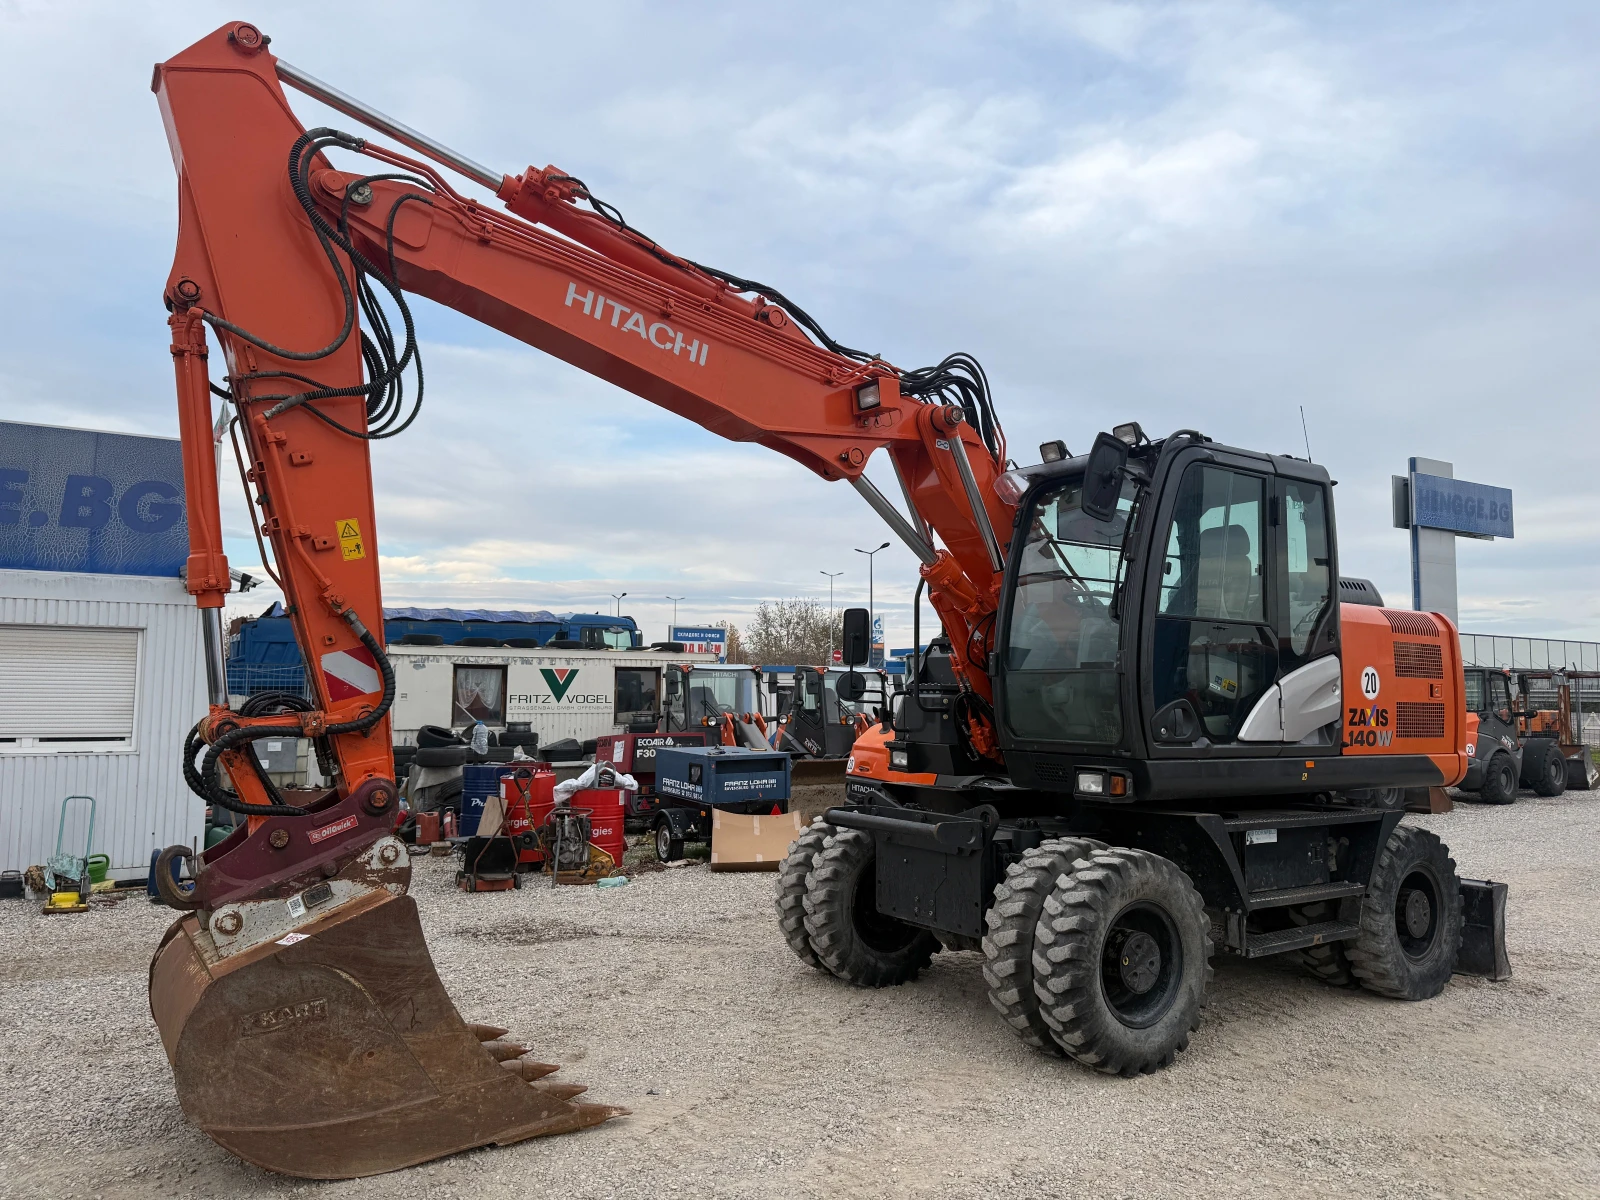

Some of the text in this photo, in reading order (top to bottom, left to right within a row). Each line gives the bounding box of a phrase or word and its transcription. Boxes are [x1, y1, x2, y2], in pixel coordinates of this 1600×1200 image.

[565, 281, 709, 367] HITACHI
[1364, 672, 1377, 694] 20
[509, 694, 613, 704] FRITZ VOGEL
[1348, 704, 1389, 727] ZAXIS
[638, 738, 665, 747] ECOAIR
[1348, 730, 1393, 747] 140W
[1467, 745, 1474, 754] 20
[662, 777, 696, 792] FRANZ LOHR
[321, 819, 351, 837] OilQuick
